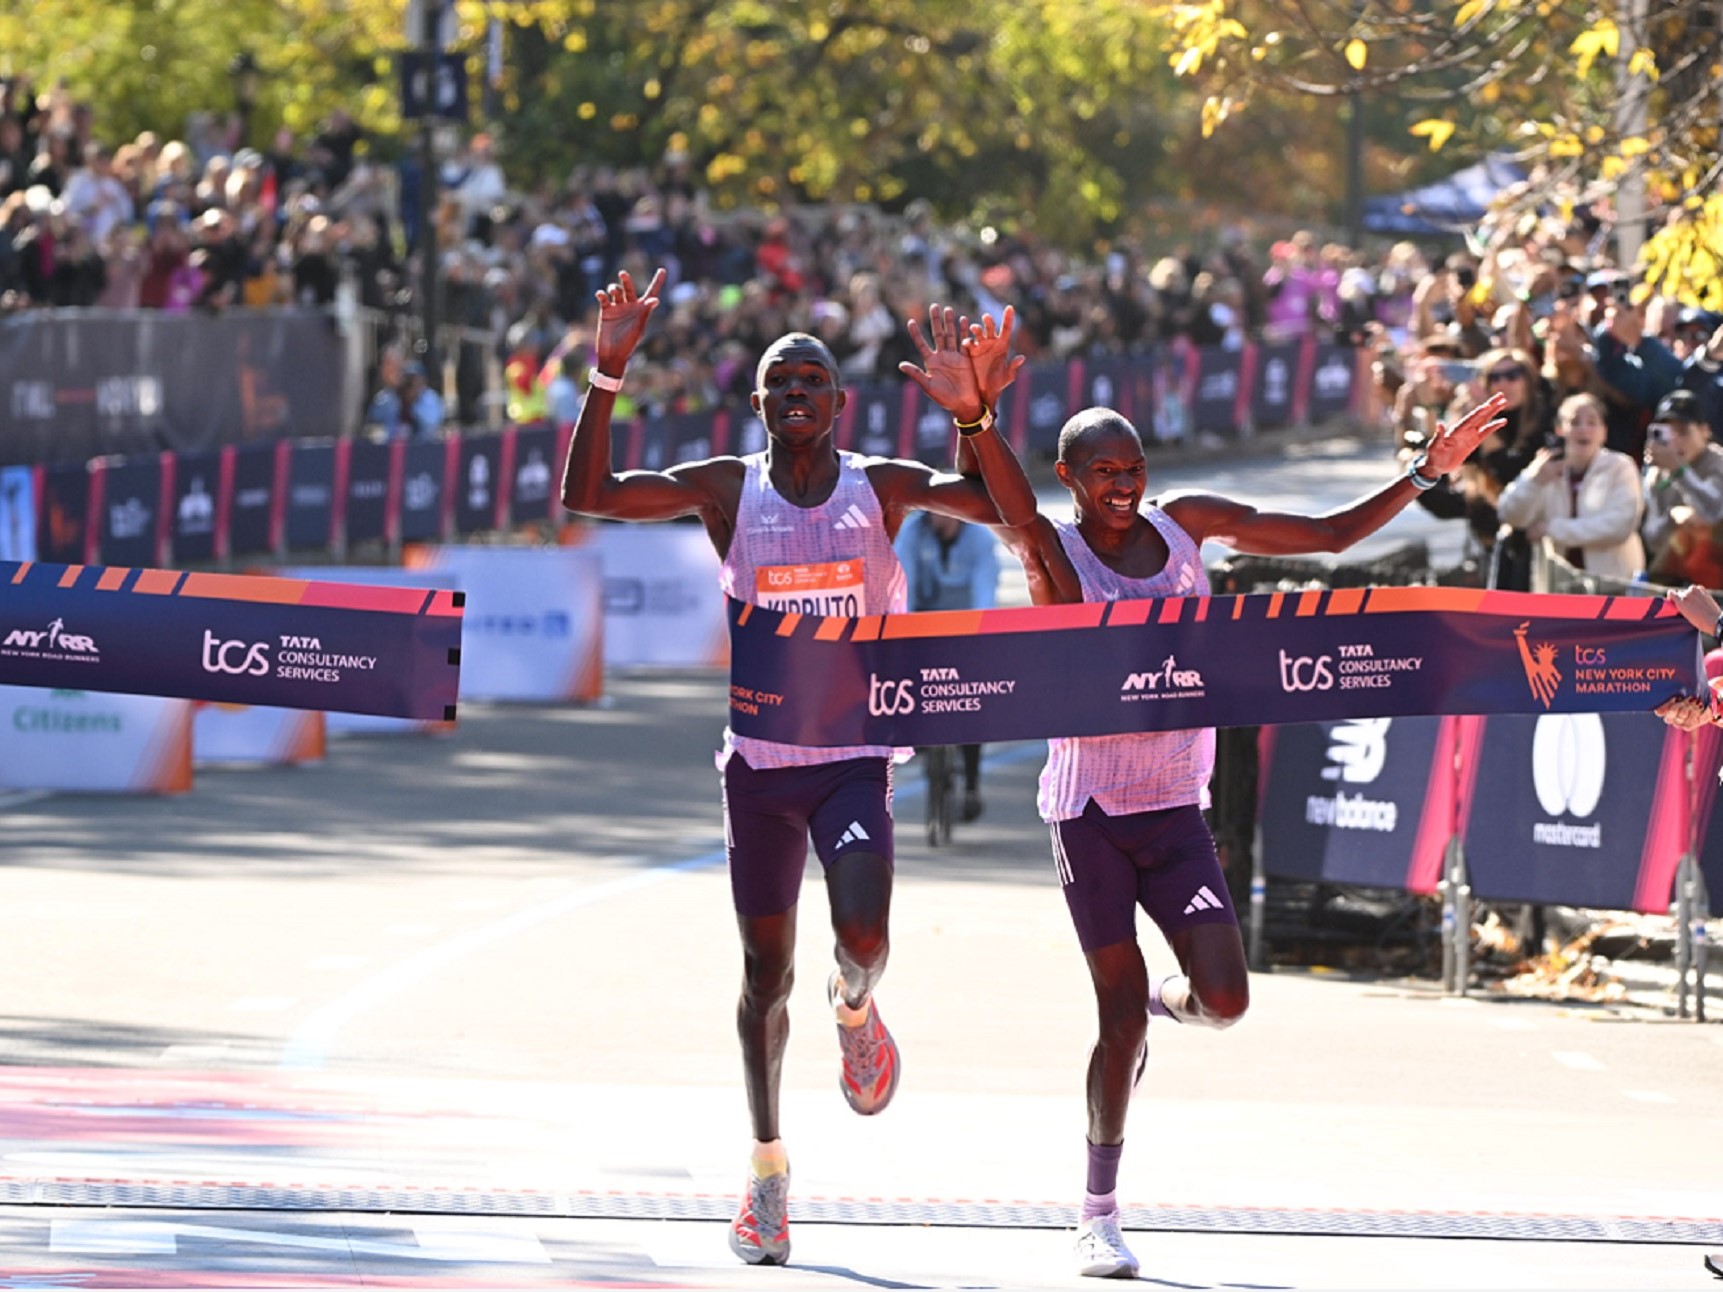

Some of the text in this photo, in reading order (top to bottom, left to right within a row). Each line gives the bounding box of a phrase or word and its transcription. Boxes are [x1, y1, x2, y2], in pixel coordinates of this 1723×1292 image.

[279, 635, 321, 650] TATA
[1338, 644, 1374, 657] TATA
[202, 629, 269, 676] tcs
[278, 651, 377, 669] CONSULTANCY
[1575, 644, 1606, 666] tcs
[276, 666, 340, 682] SERVICES
[1279, 649, 1334, 692] tcs
[1338, 657, 1423, 674] CONSULTANCY
[1575, 668, 1676, 680] NEW YORK CITY
[920, 668, 959, 681] TATA
[1339, 674, 1392, 690] SERVICES
[730, 685, 784, 706] ORK CITY
[868, 672, 915, 717] tcs
[920, 681, 1016, 698] CONSULTANCY
[1575, 681, 1651, 693] MARATHON
[921, 697, 982, 713] SERVICES
[12, 704, 123, 734] Citizens
[1533, 820, 1601, 849] mastercard
